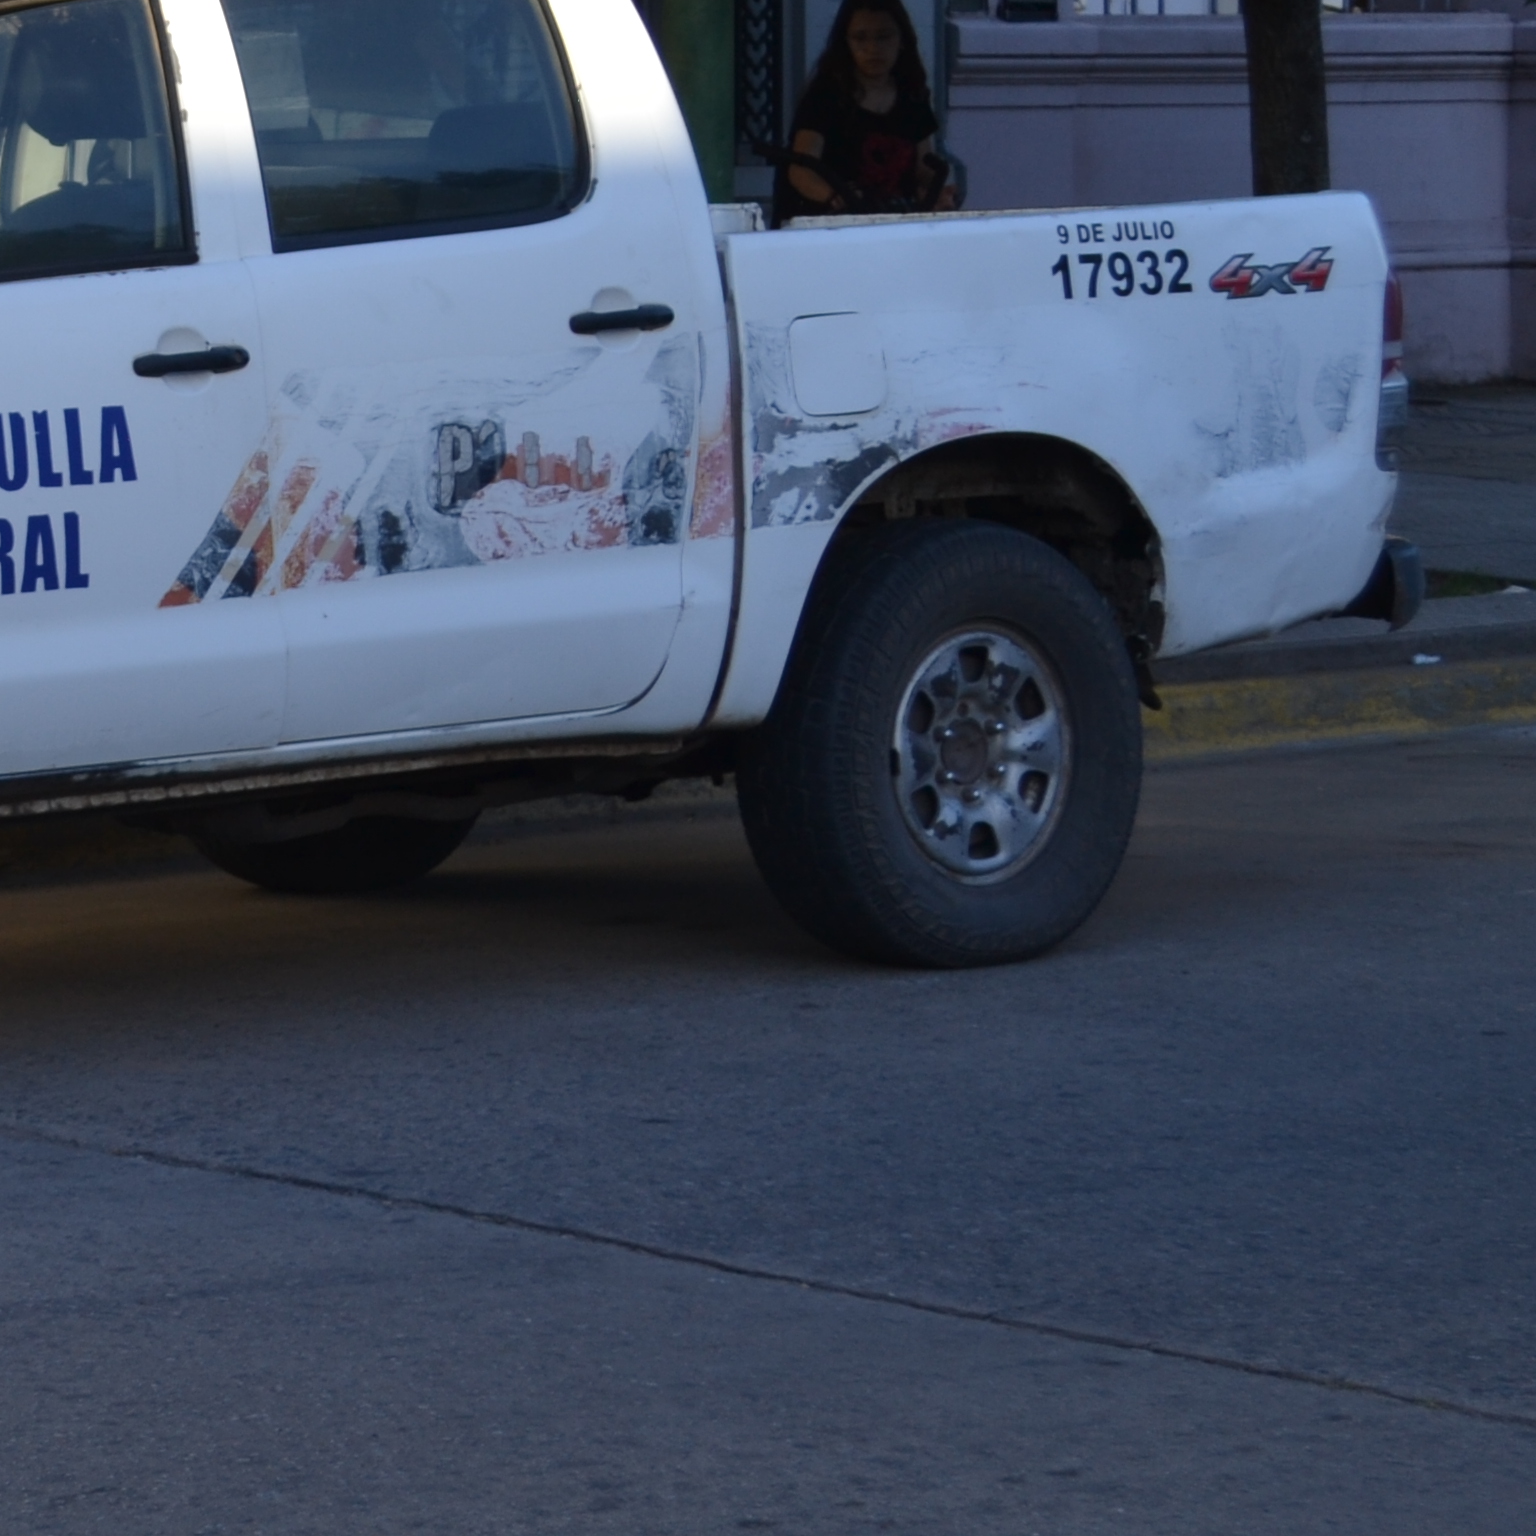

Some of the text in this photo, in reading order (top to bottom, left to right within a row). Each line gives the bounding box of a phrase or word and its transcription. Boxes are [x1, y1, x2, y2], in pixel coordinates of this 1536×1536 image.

[1057, 220, 1175, 244] 9 DE JULIO
[1051, 248, 1193, 300] 17932
